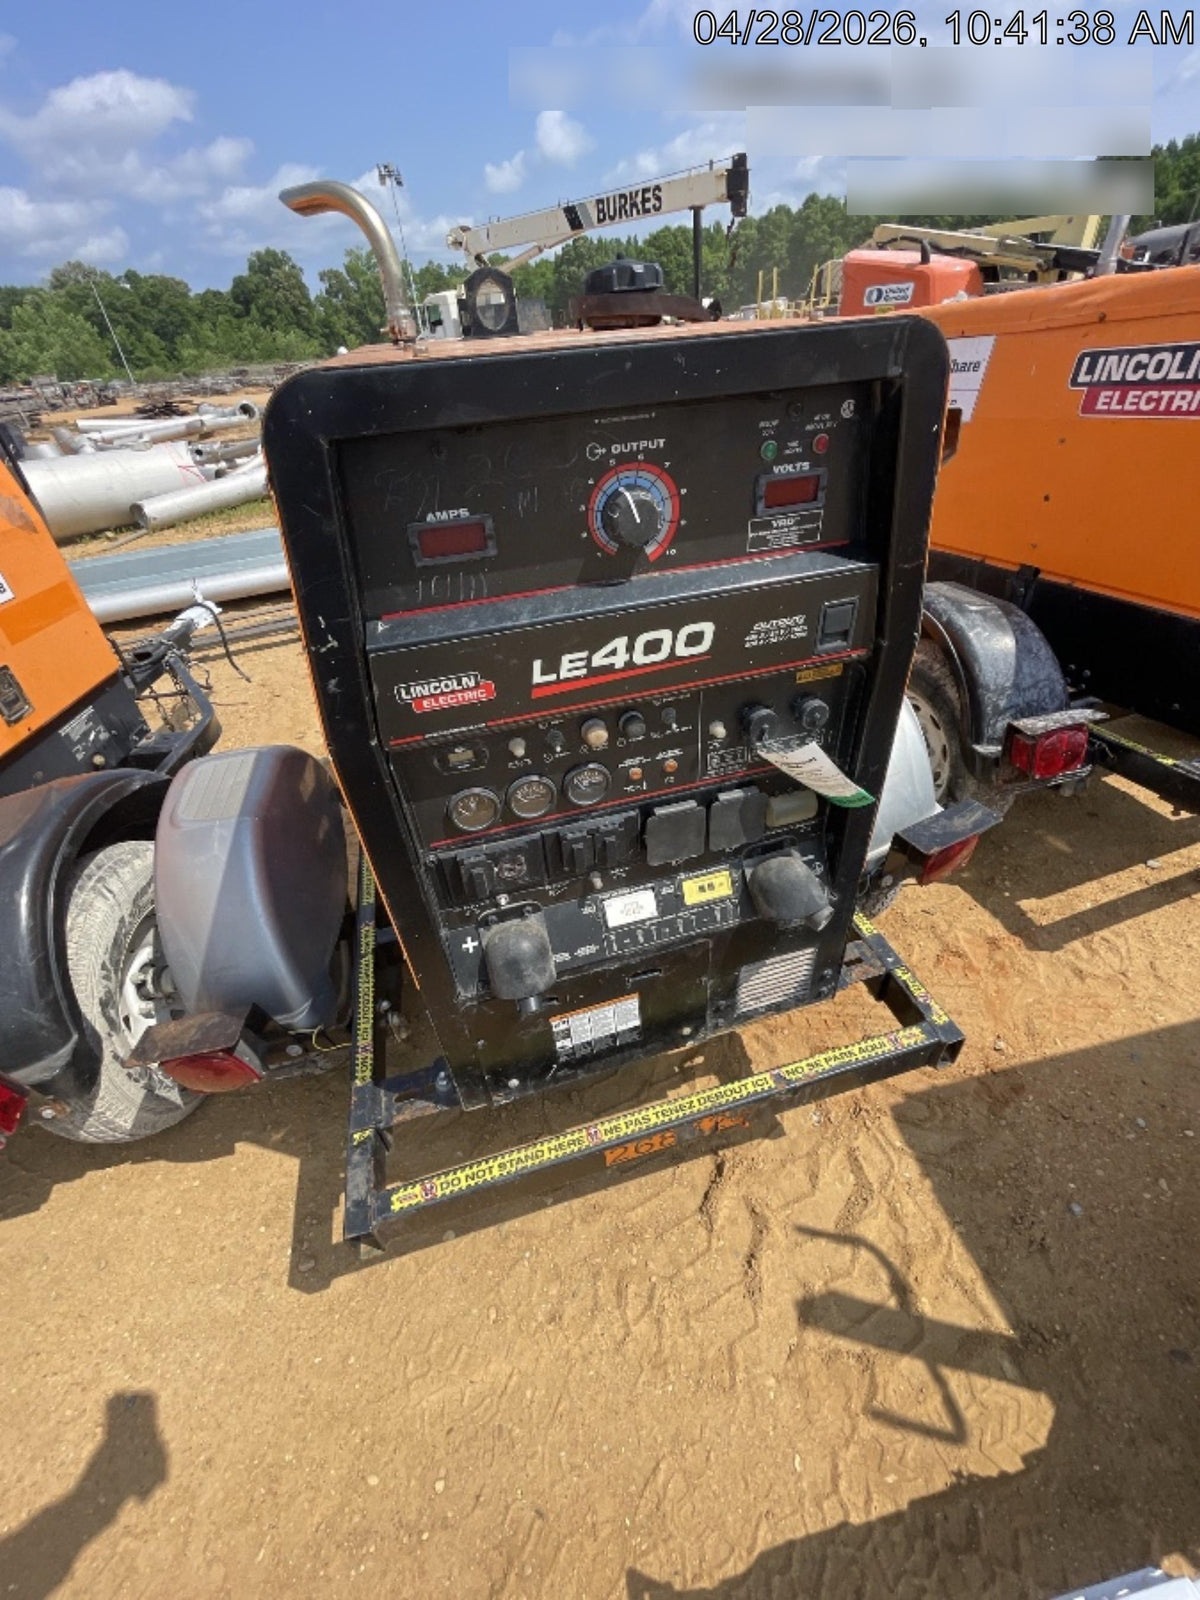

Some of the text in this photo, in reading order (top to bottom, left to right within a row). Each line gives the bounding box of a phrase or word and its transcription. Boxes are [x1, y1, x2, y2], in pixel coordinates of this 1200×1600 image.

[595, 184, 662, 224] BURKES
[611, 438, 666, 454] OUTPUT
[773, 462, 811, 474] VOLTS
[426, 508, 470, 522] AMPS
[666, 548, 677, 556] 10
[532, 622, 716, 685] LE400
[400, 675, 476, 700] LINCOLN
[422, 689, 487, 709] ELECTRIC
[785, 1066, 804, 1077] NO
[603, 1077, 769, 1136] NE PAS TENEZ DEBOUT ICI
[440, 1135, 585, 1191] DO NOT STAND HERE
